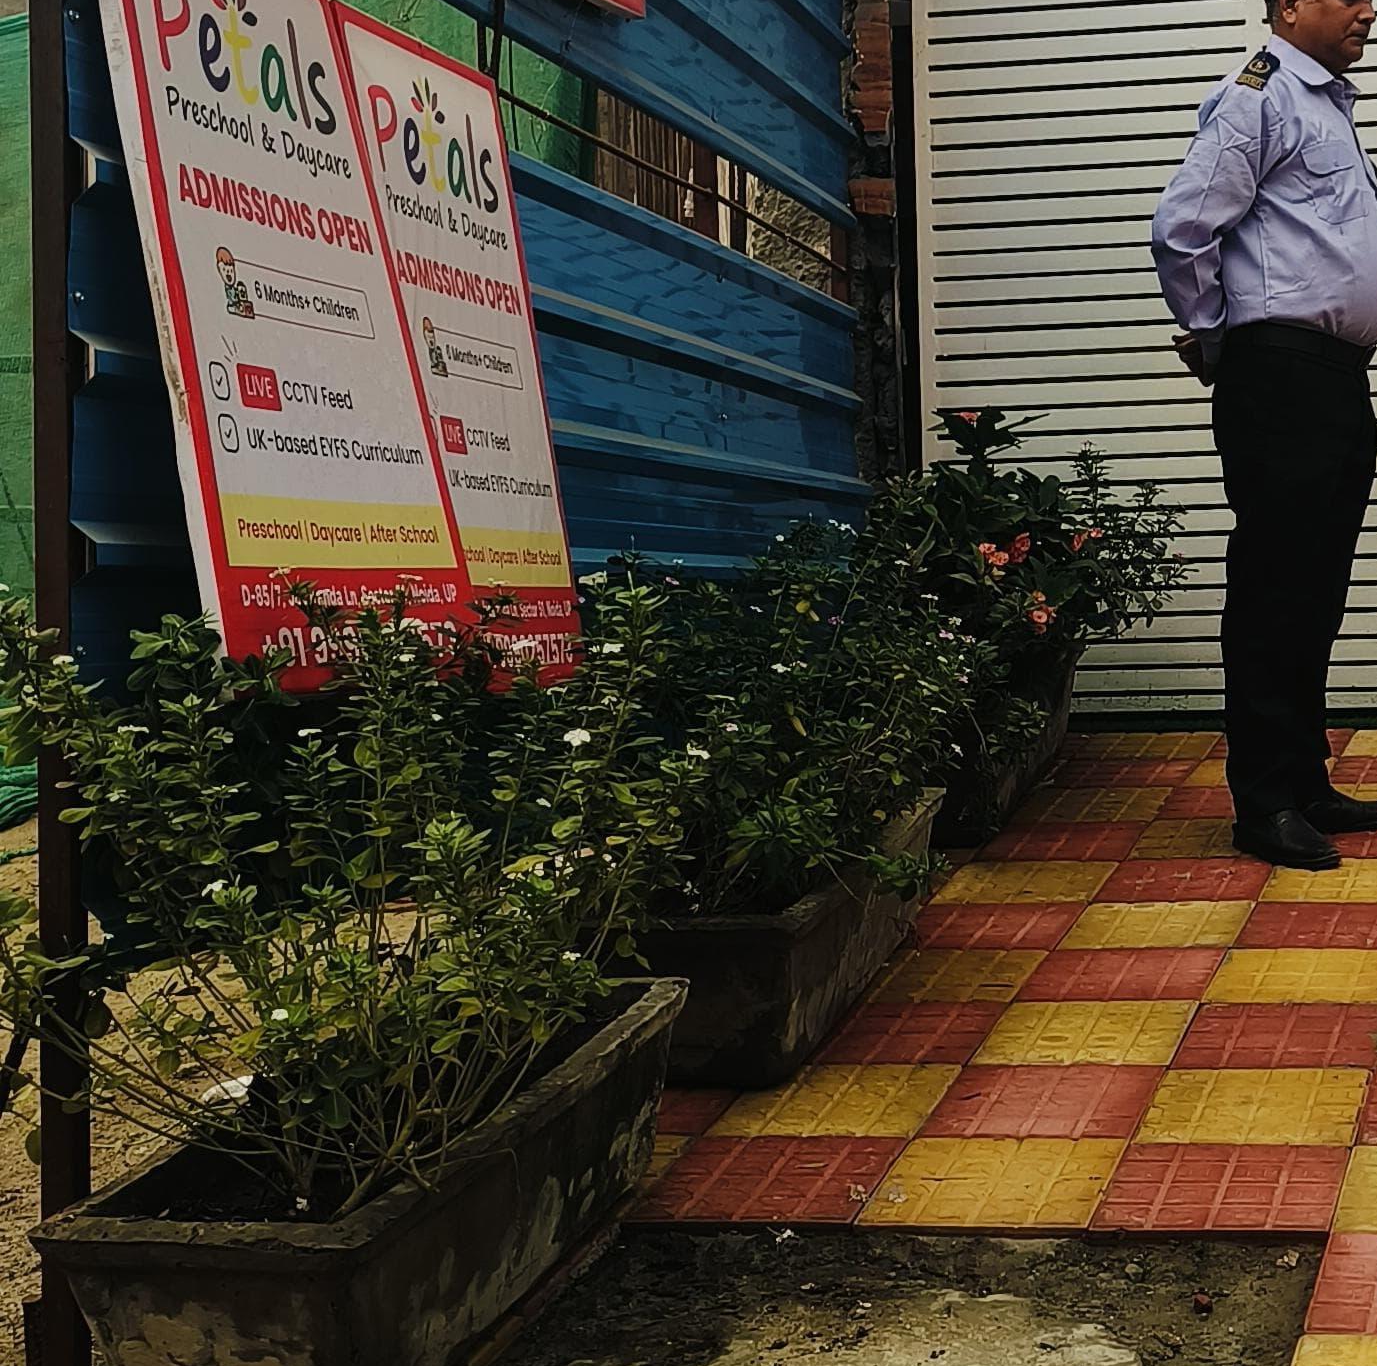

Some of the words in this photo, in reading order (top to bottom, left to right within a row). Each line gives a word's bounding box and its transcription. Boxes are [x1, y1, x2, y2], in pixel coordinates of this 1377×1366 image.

[165, 85, 255, 147] Preschool
[261, 122, 277, 154] &
[280, 130, 352, 179] Daycare
[368, 84, 499, 214] Petals
[179, 162, 316, 240] ADMISSIONS
[317, 207, 374, 256] OPEN
[385, 184, 444, 229] Preschool
[447, 207, 459, 234] &
[460, 211, 508, 252] Daycare
[254, 280, 263, 300] 6
[264, 283, 311, 310] Months+
[312, 295, 360, 322] Children
[396, 249, 485, 307] ADMISSIONS
[485, 276, 522, 316] OPEN
[244, 372, 275, 399] LIVE
[282, 380, 319, 406] CCTV
[321, 385, 354, 410] Feed
[246, 426, 318, 456] UK-based
[320, 436, 350, 460] EYFS
[351, 439, 425, 466] Curriculum
[466, 428, 490, 448] CCTV
[237, 517, 303, 541] Preschool
[310, 522, 363, 548] Daycare
[370, 524, 398, 544] After
[399, 525, 440, 545] School
[441, 583, 457, 604] UP
[261, 626, 307, 667] +91
